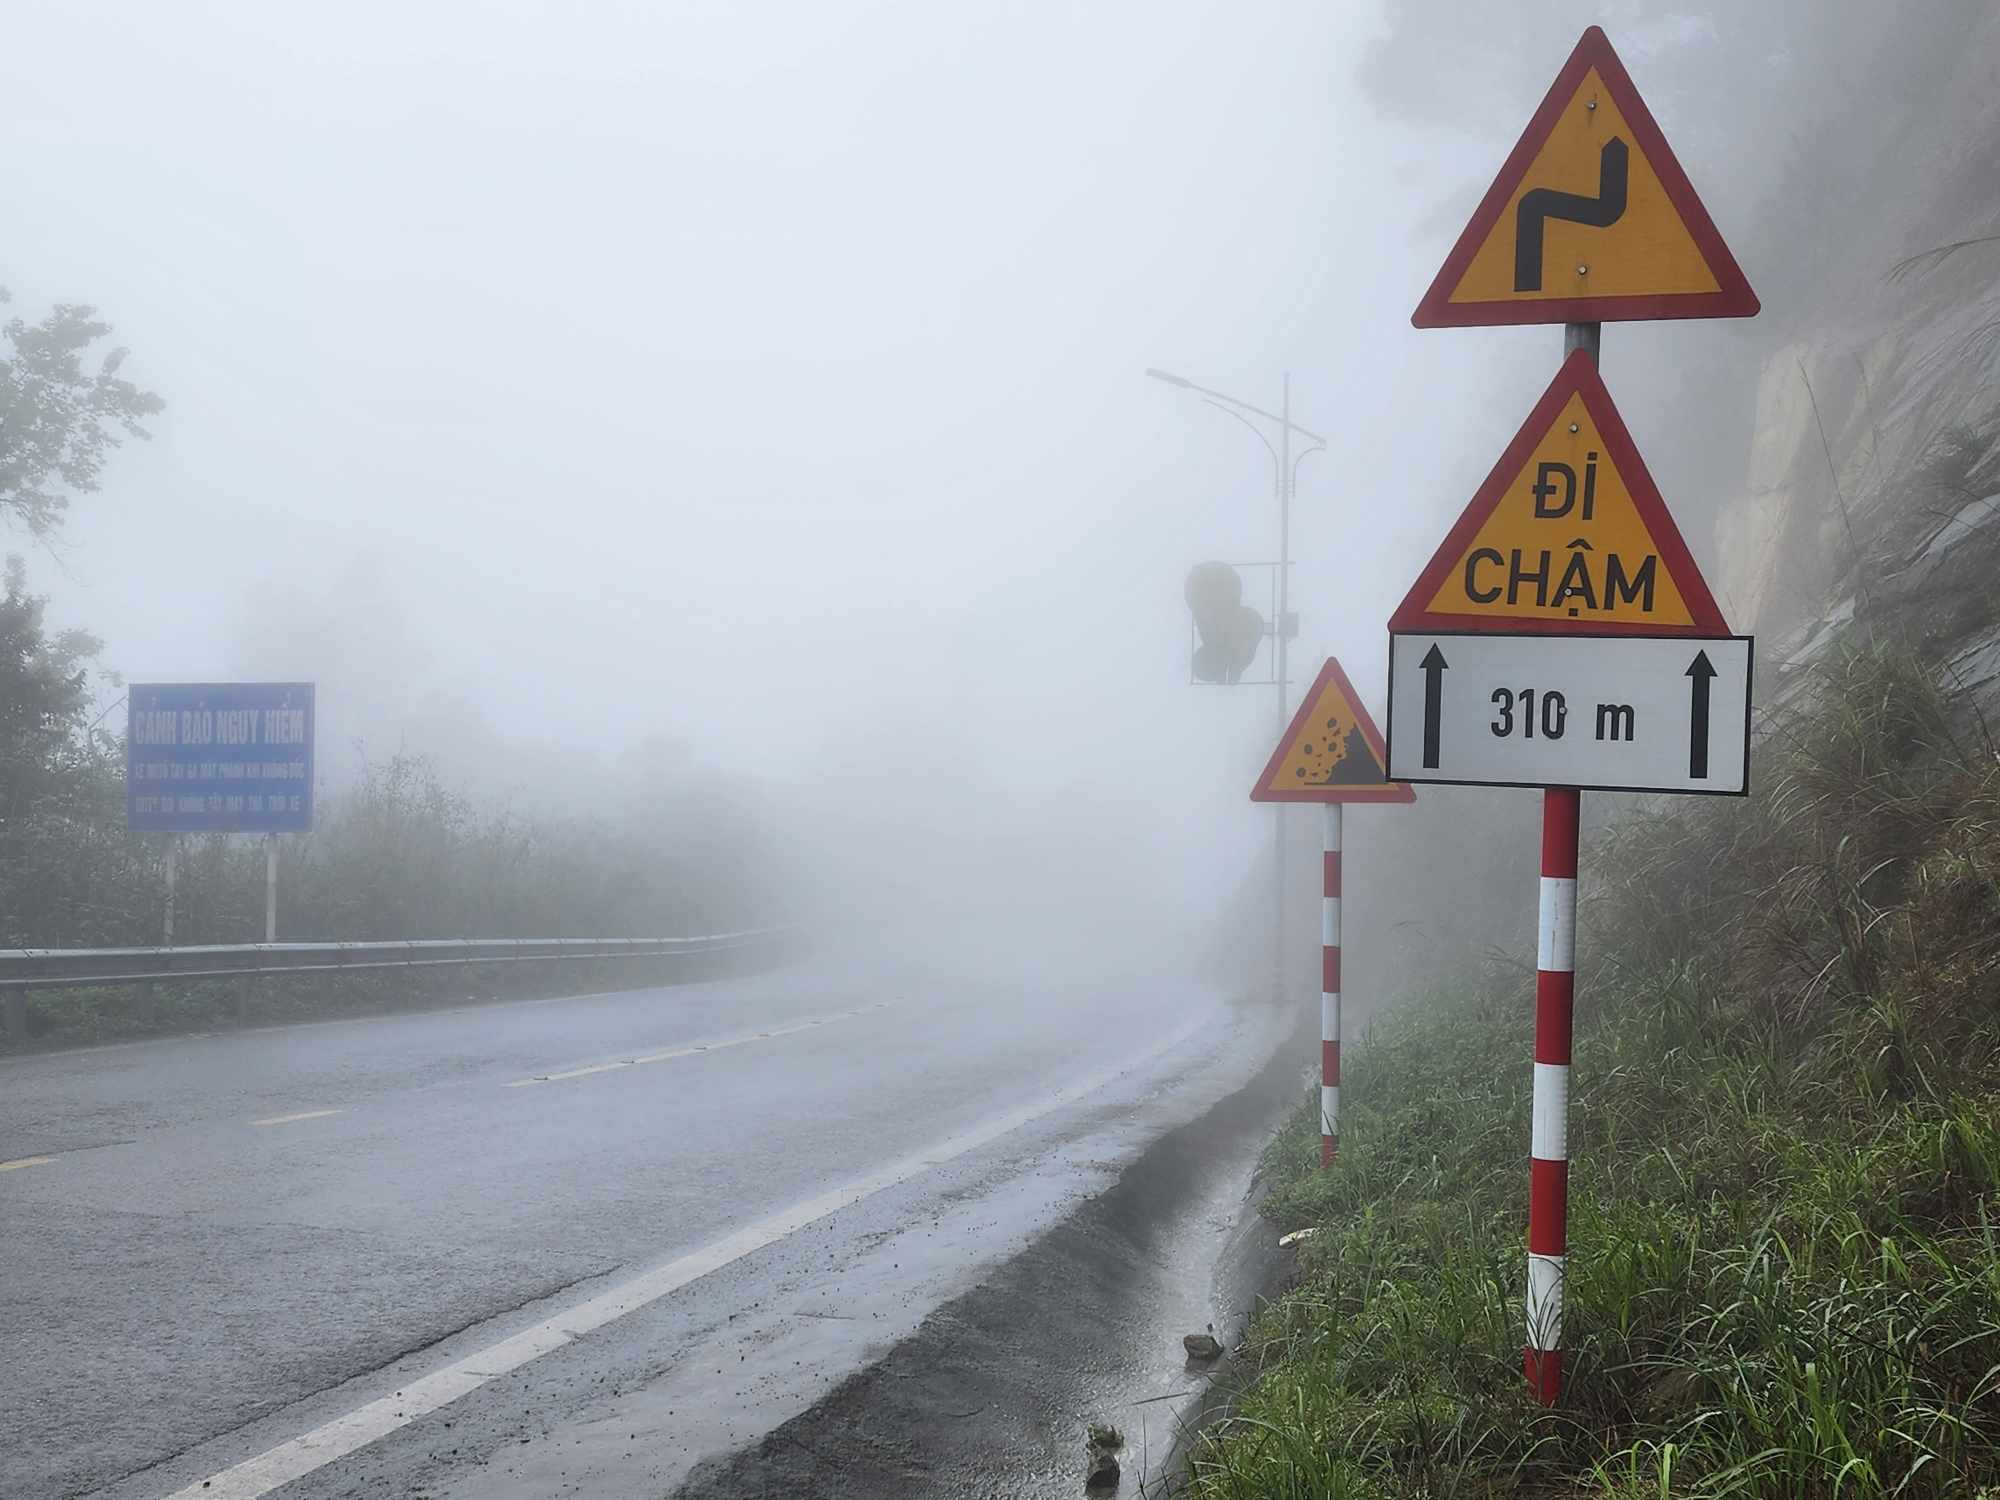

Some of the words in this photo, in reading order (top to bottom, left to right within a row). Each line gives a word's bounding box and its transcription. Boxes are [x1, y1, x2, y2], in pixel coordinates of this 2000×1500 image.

[1464, 538, 1657, 617] CHẬM
[216, 709, 259, 745] NGUY
[1490, 687, 1567, 740] 310
[1596, 703, 1634, 741] m
